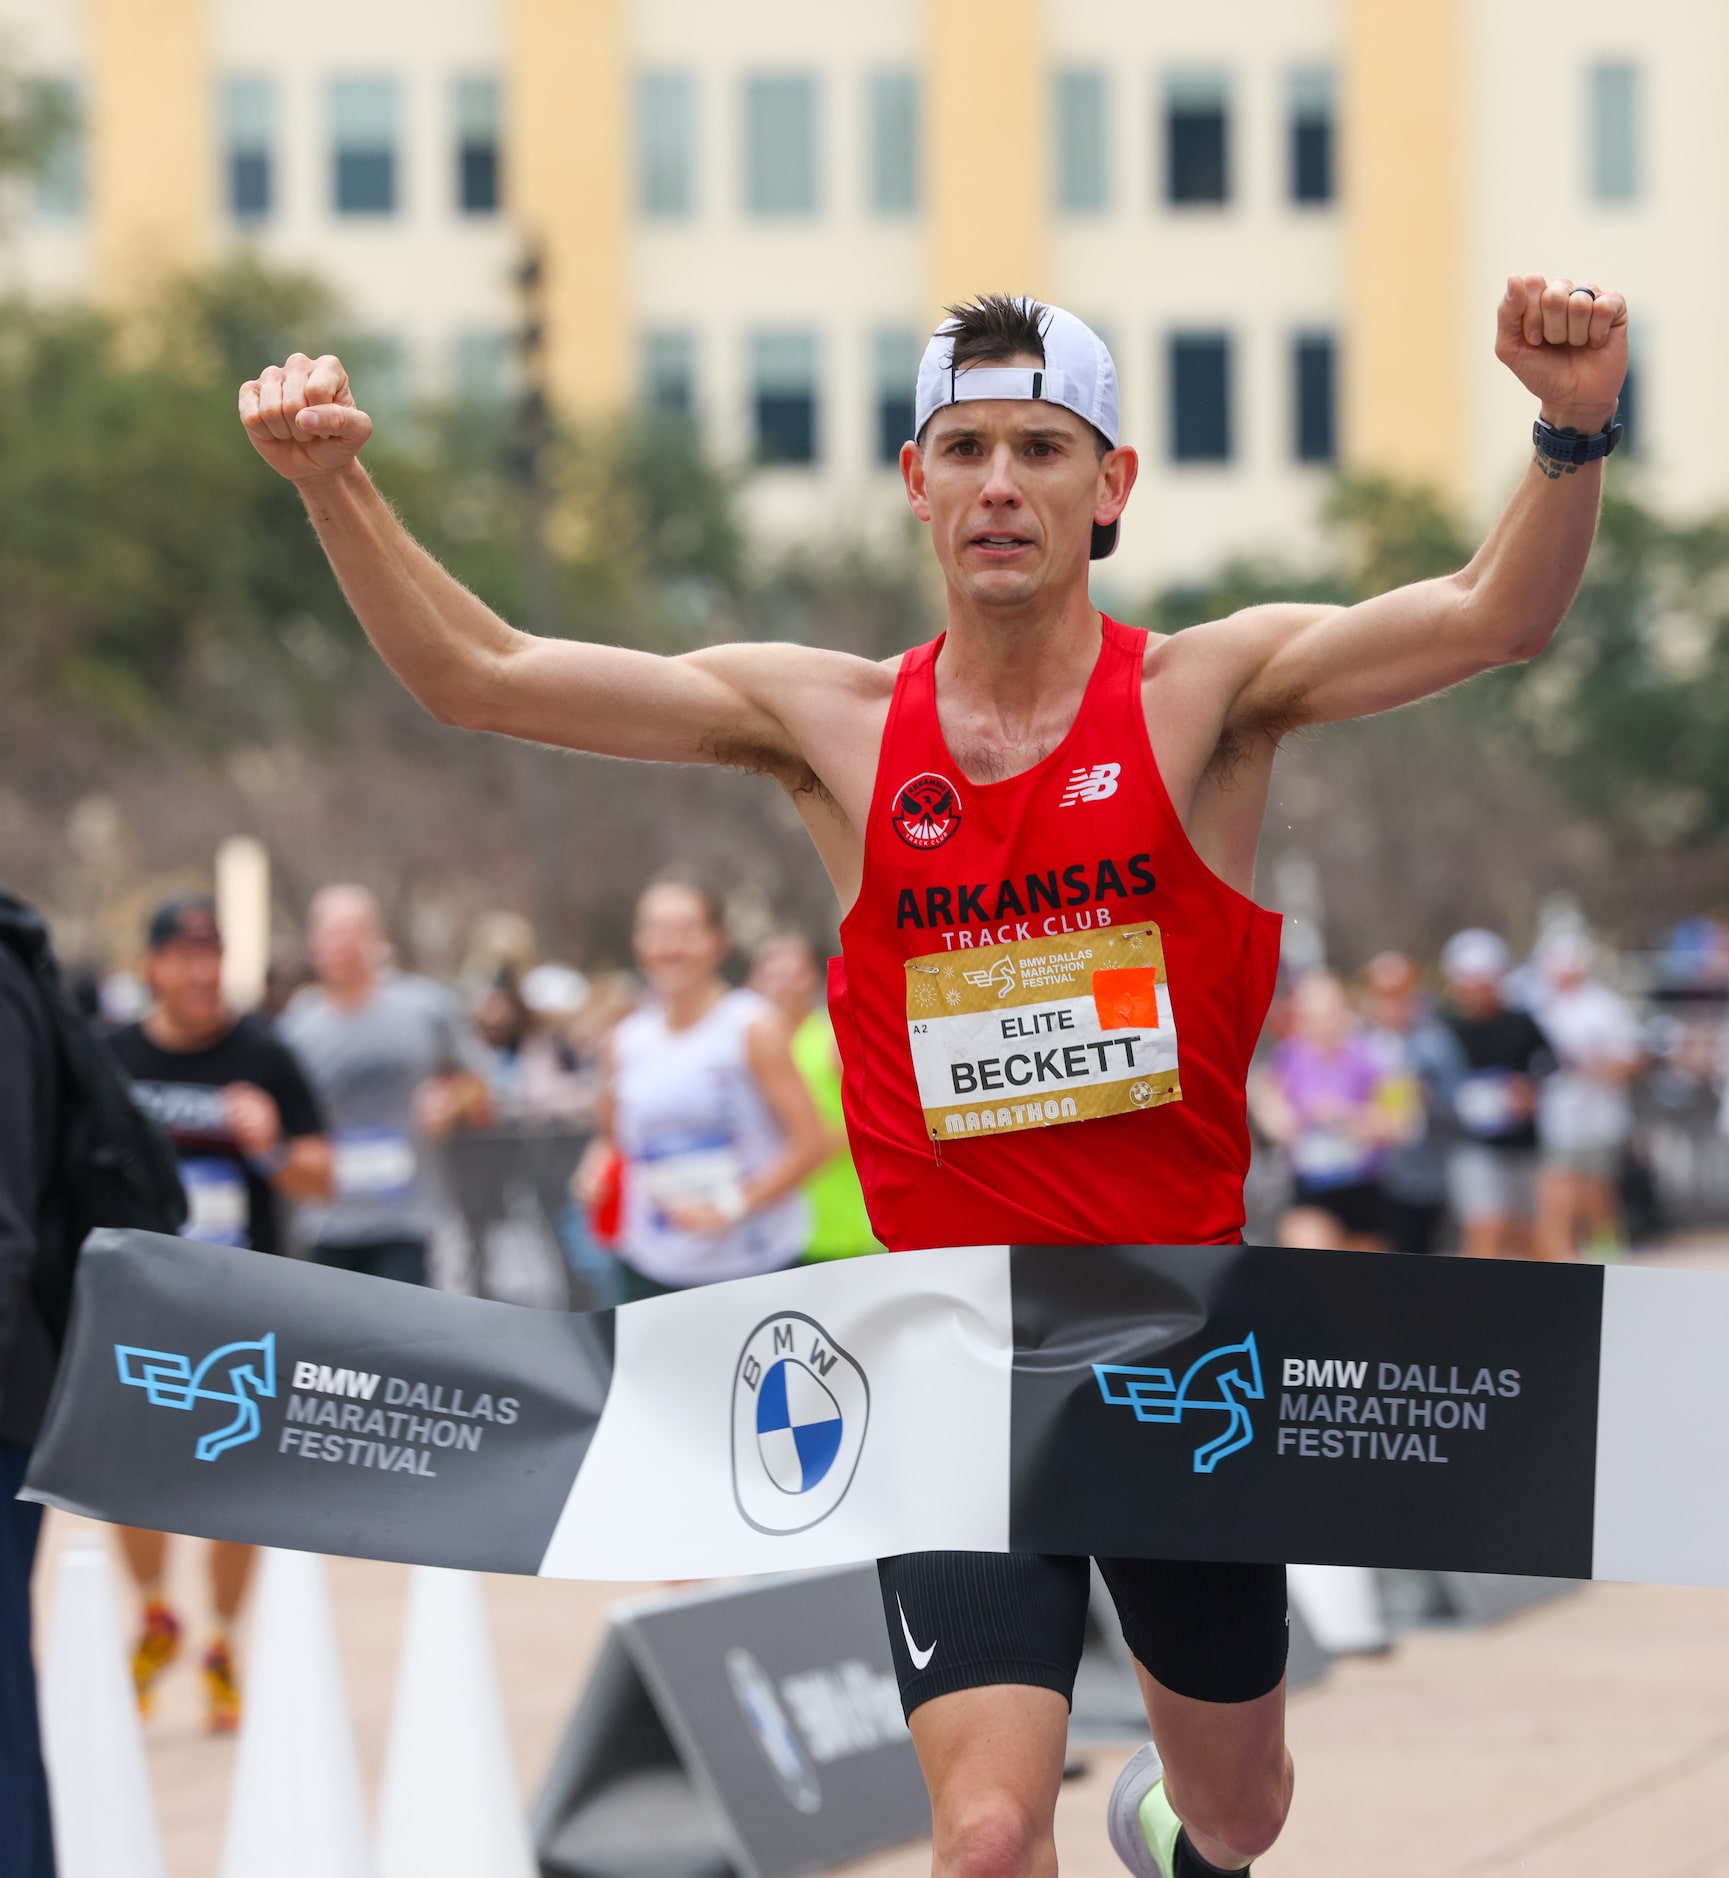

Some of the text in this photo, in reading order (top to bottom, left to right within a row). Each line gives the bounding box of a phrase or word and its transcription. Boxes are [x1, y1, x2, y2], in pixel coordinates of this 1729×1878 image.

[905, 833, 929, 846] TRACK
[897, 854, 1156, 929] ARKANSAS
[942, 908, 1112, 950] TRACK CLUB
[1019, 949, 1093, 969] BMW DALLAS
[1021, 960, 1085, 978] MARATHON
[1022, 972, 1076, 989] FESTIVAL
[1000, 1009, 1075, 1039] ELITE
[950, 1036, 1140, 1093] BECKETT
[945, 1097, 1077, 1133] MARATHON
[743, 1323, 838, 1392] BMW
[292, 1361, 521, 1425] BMW DALLAS
[1282, 1358, 1521, 1398] BMW DALLAS
[286, 1394, 483, 1452] MARATHON
[1279, 1393, 1486, 1430] MARATHON
[278, 1427, 437, 1478] FESTIVAL
[1277, 1427, 1449, 1463] FESTIVAL
